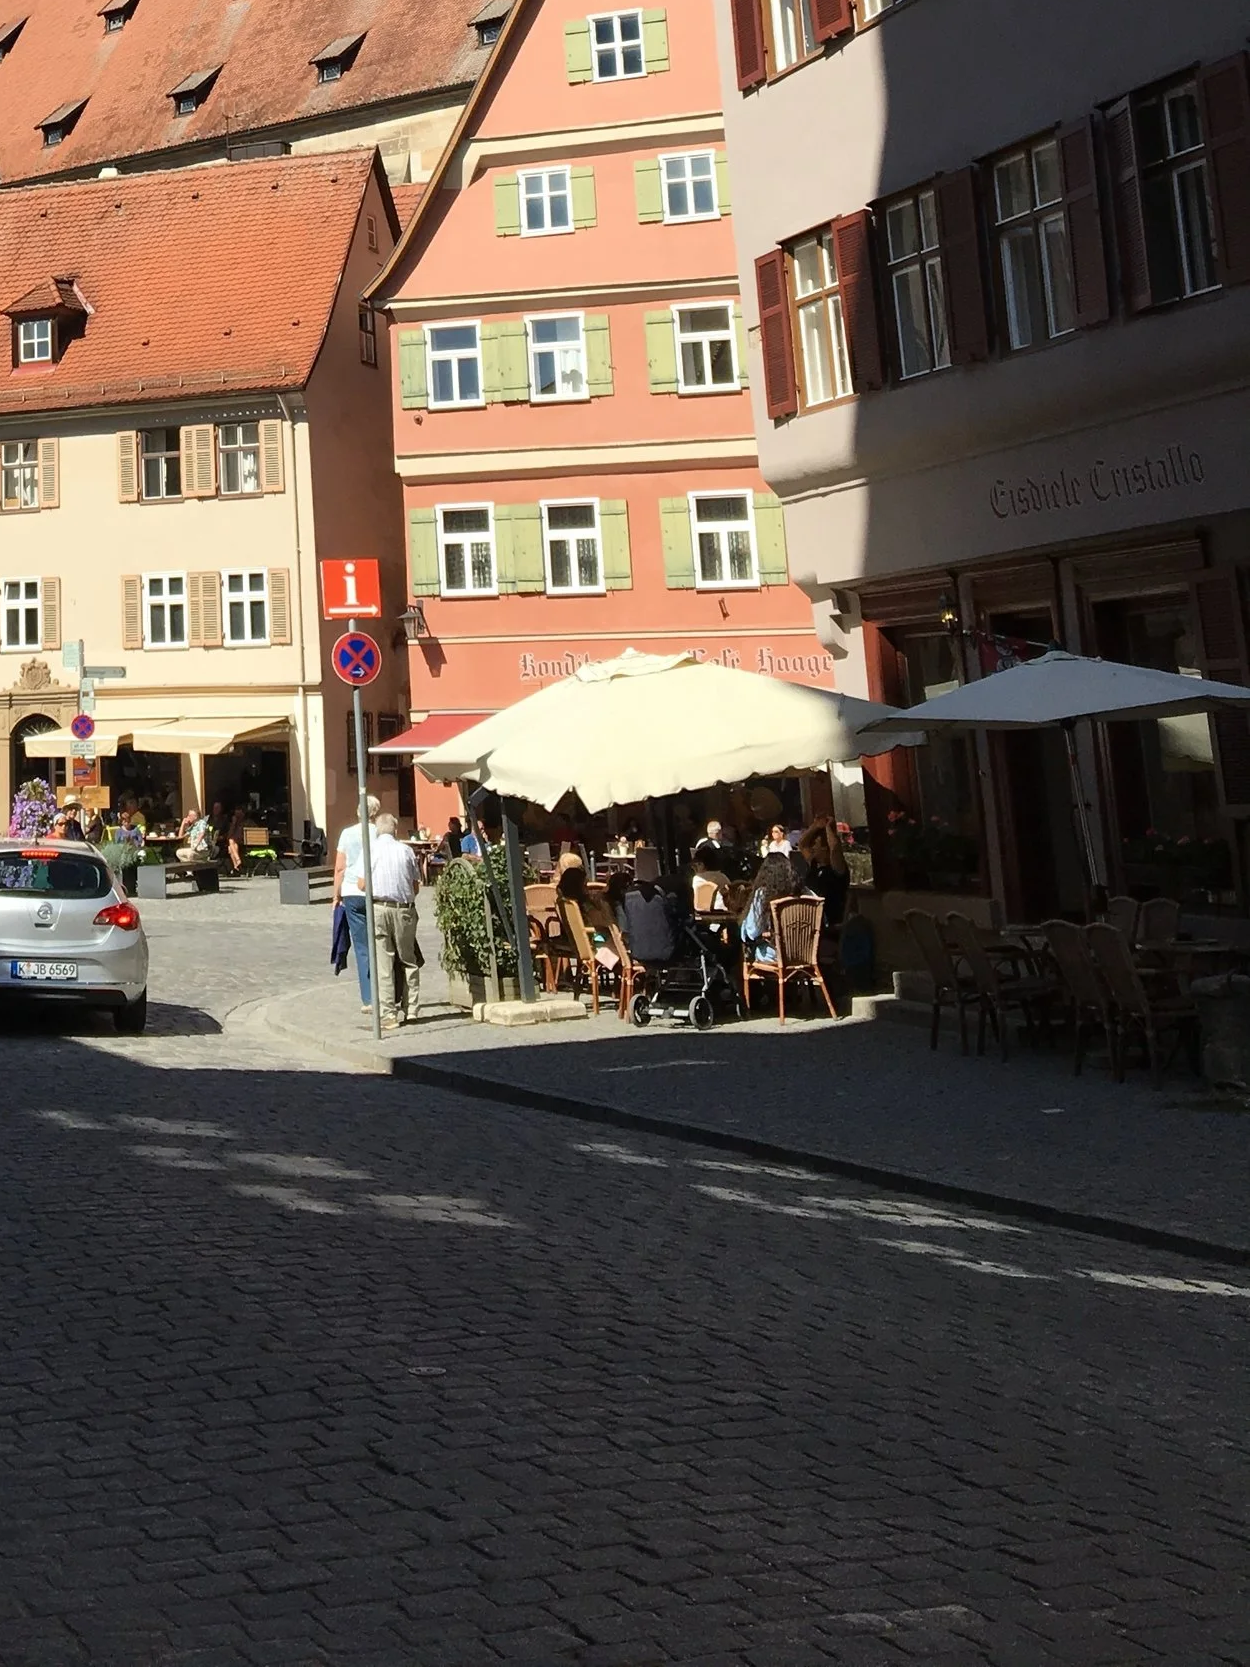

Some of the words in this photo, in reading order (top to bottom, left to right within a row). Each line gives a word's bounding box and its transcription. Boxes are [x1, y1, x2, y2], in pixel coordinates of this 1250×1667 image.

[989, 469, 1082, 519] Eisdiele
[1089, 445, 1206, 502] Cristallo
[18, 963, 26, 975] K
[33, 964, 47, 975] JB
[49, 964, 76, 976] 6569
